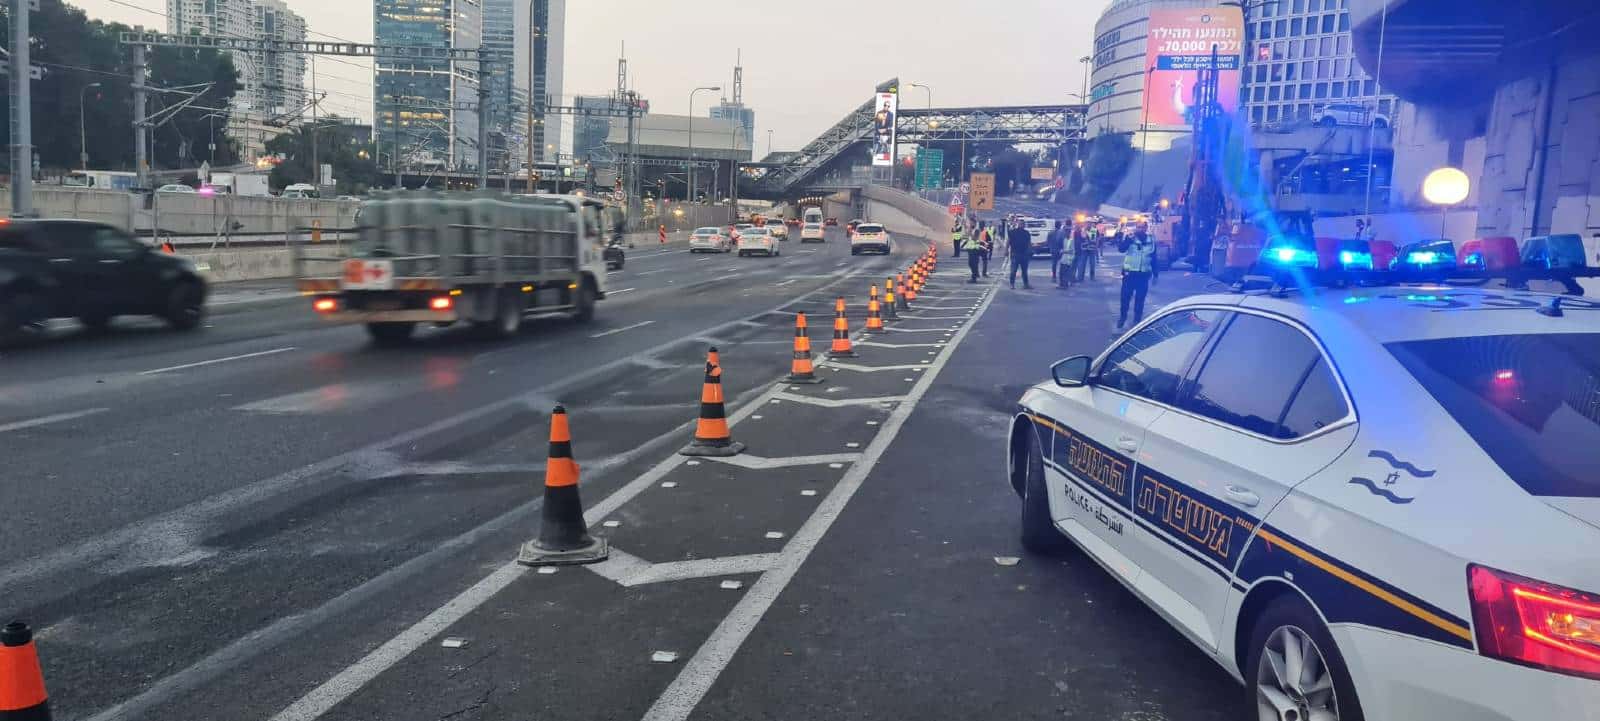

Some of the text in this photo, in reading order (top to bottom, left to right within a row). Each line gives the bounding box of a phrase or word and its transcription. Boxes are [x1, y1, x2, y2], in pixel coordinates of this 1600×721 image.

[1152, 27, 1192, 40] מהילד
[1064, 483, 1089, 513] POLICE
[1068, 436, 1234, 558] משטרת התנועה
[1095, 505, 1124, 536] الشرطة
